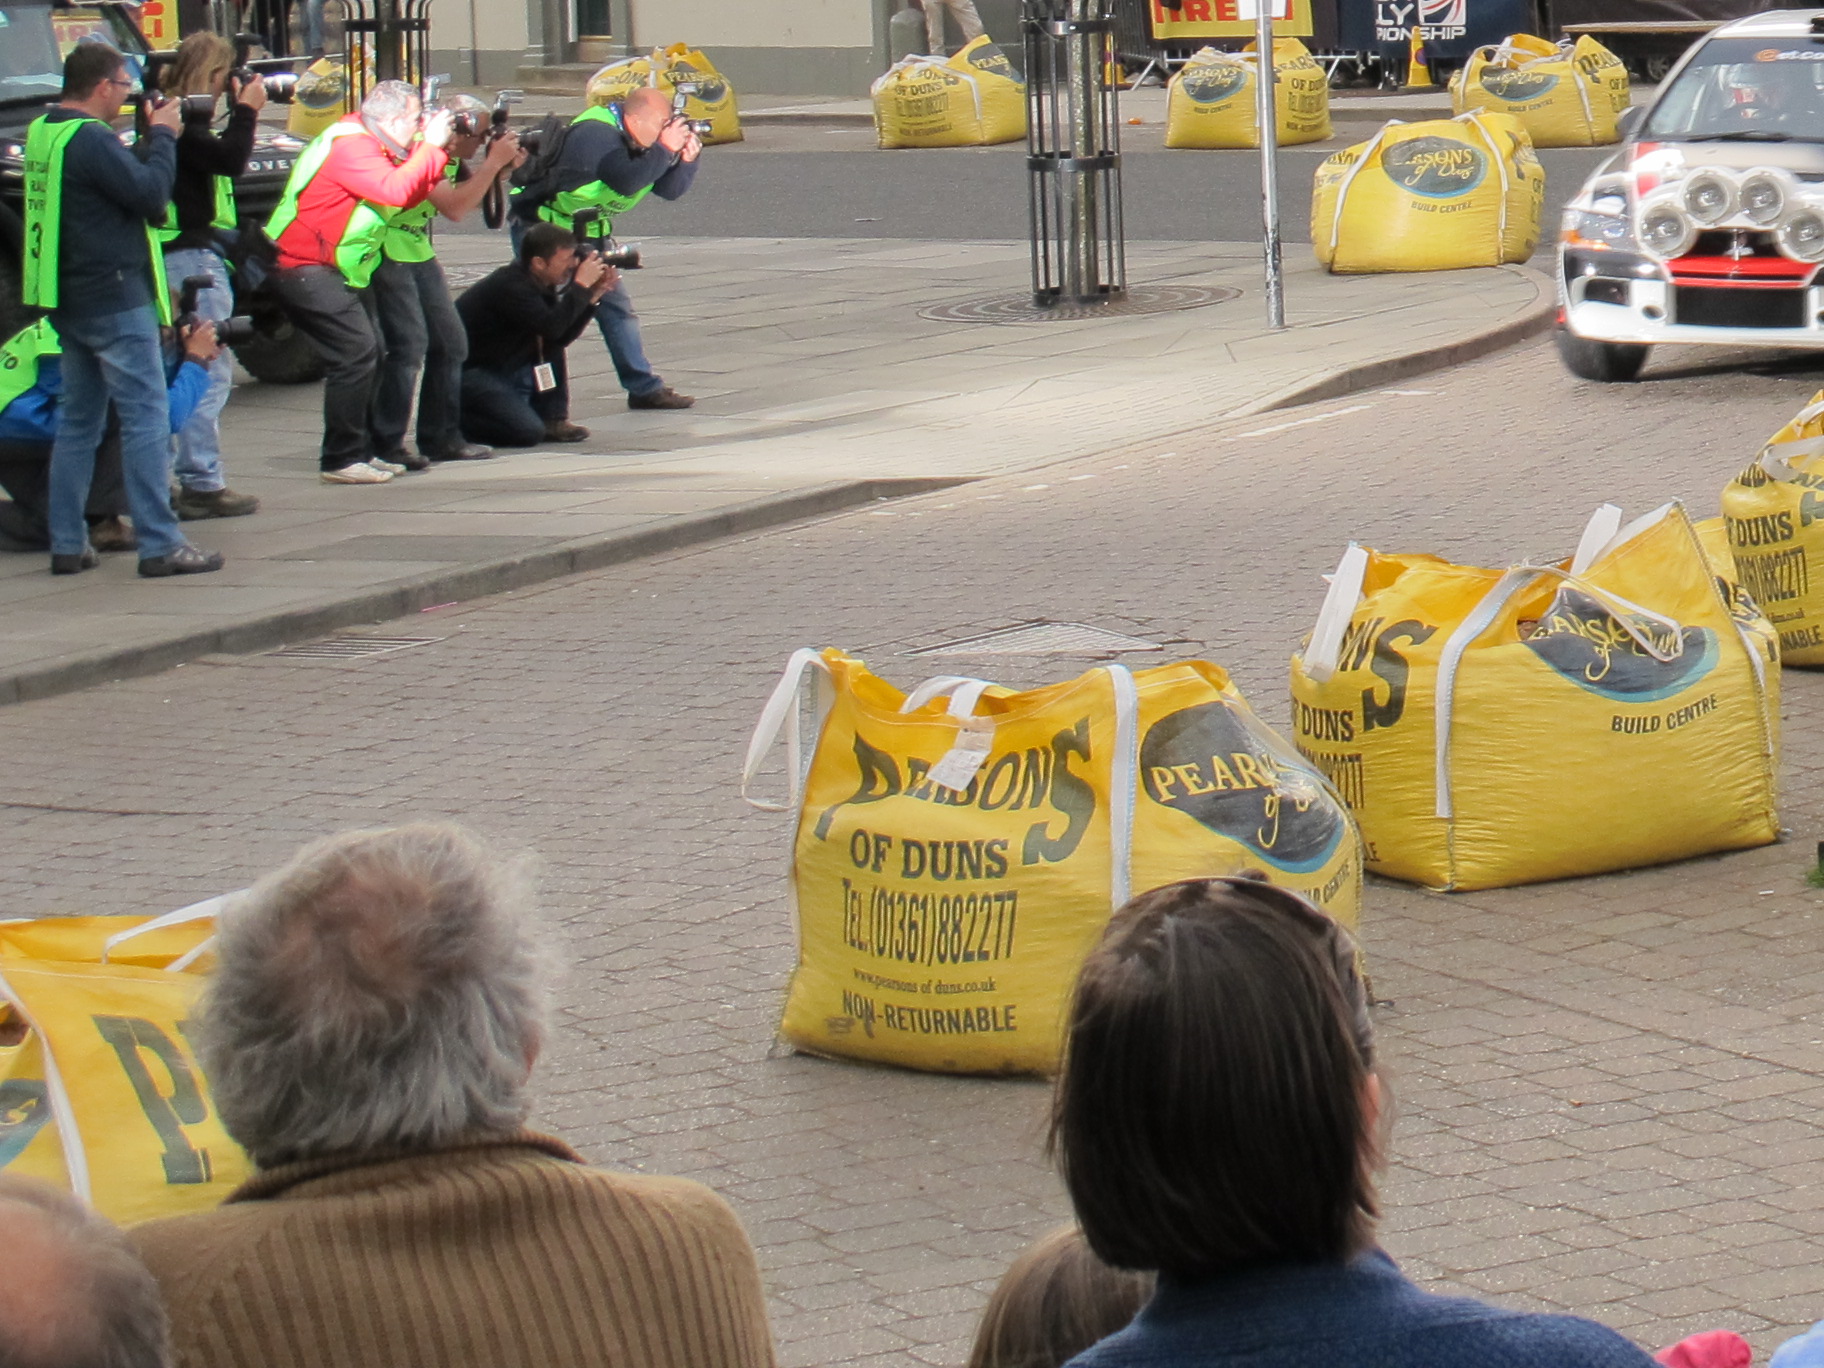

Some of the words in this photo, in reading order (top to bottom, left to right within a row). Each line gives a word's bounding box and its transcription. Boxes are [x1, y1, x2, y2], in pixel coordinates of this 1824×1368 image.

[910, 83, 943, 97] DUNS
[1411, 200, 1436, 212] BUILD
[1439, 200, 1473, 214] CENTRE
[1735, 510, 1795, 548] DUNS
[1302, 704, 1354, 742] DUNS
[1611, 714, 1661, 734] BUILD
[1666, 693, 1719, 731] CENTRE
[850, 828, 892, 874] OF
[901, 838, 1009, 882] DUNS
[921, 979, 932, 994] of
[934, 976, 997, 995] duns.co.uk
[842, 988, 1018, 1035] NON-RETURNABLE
